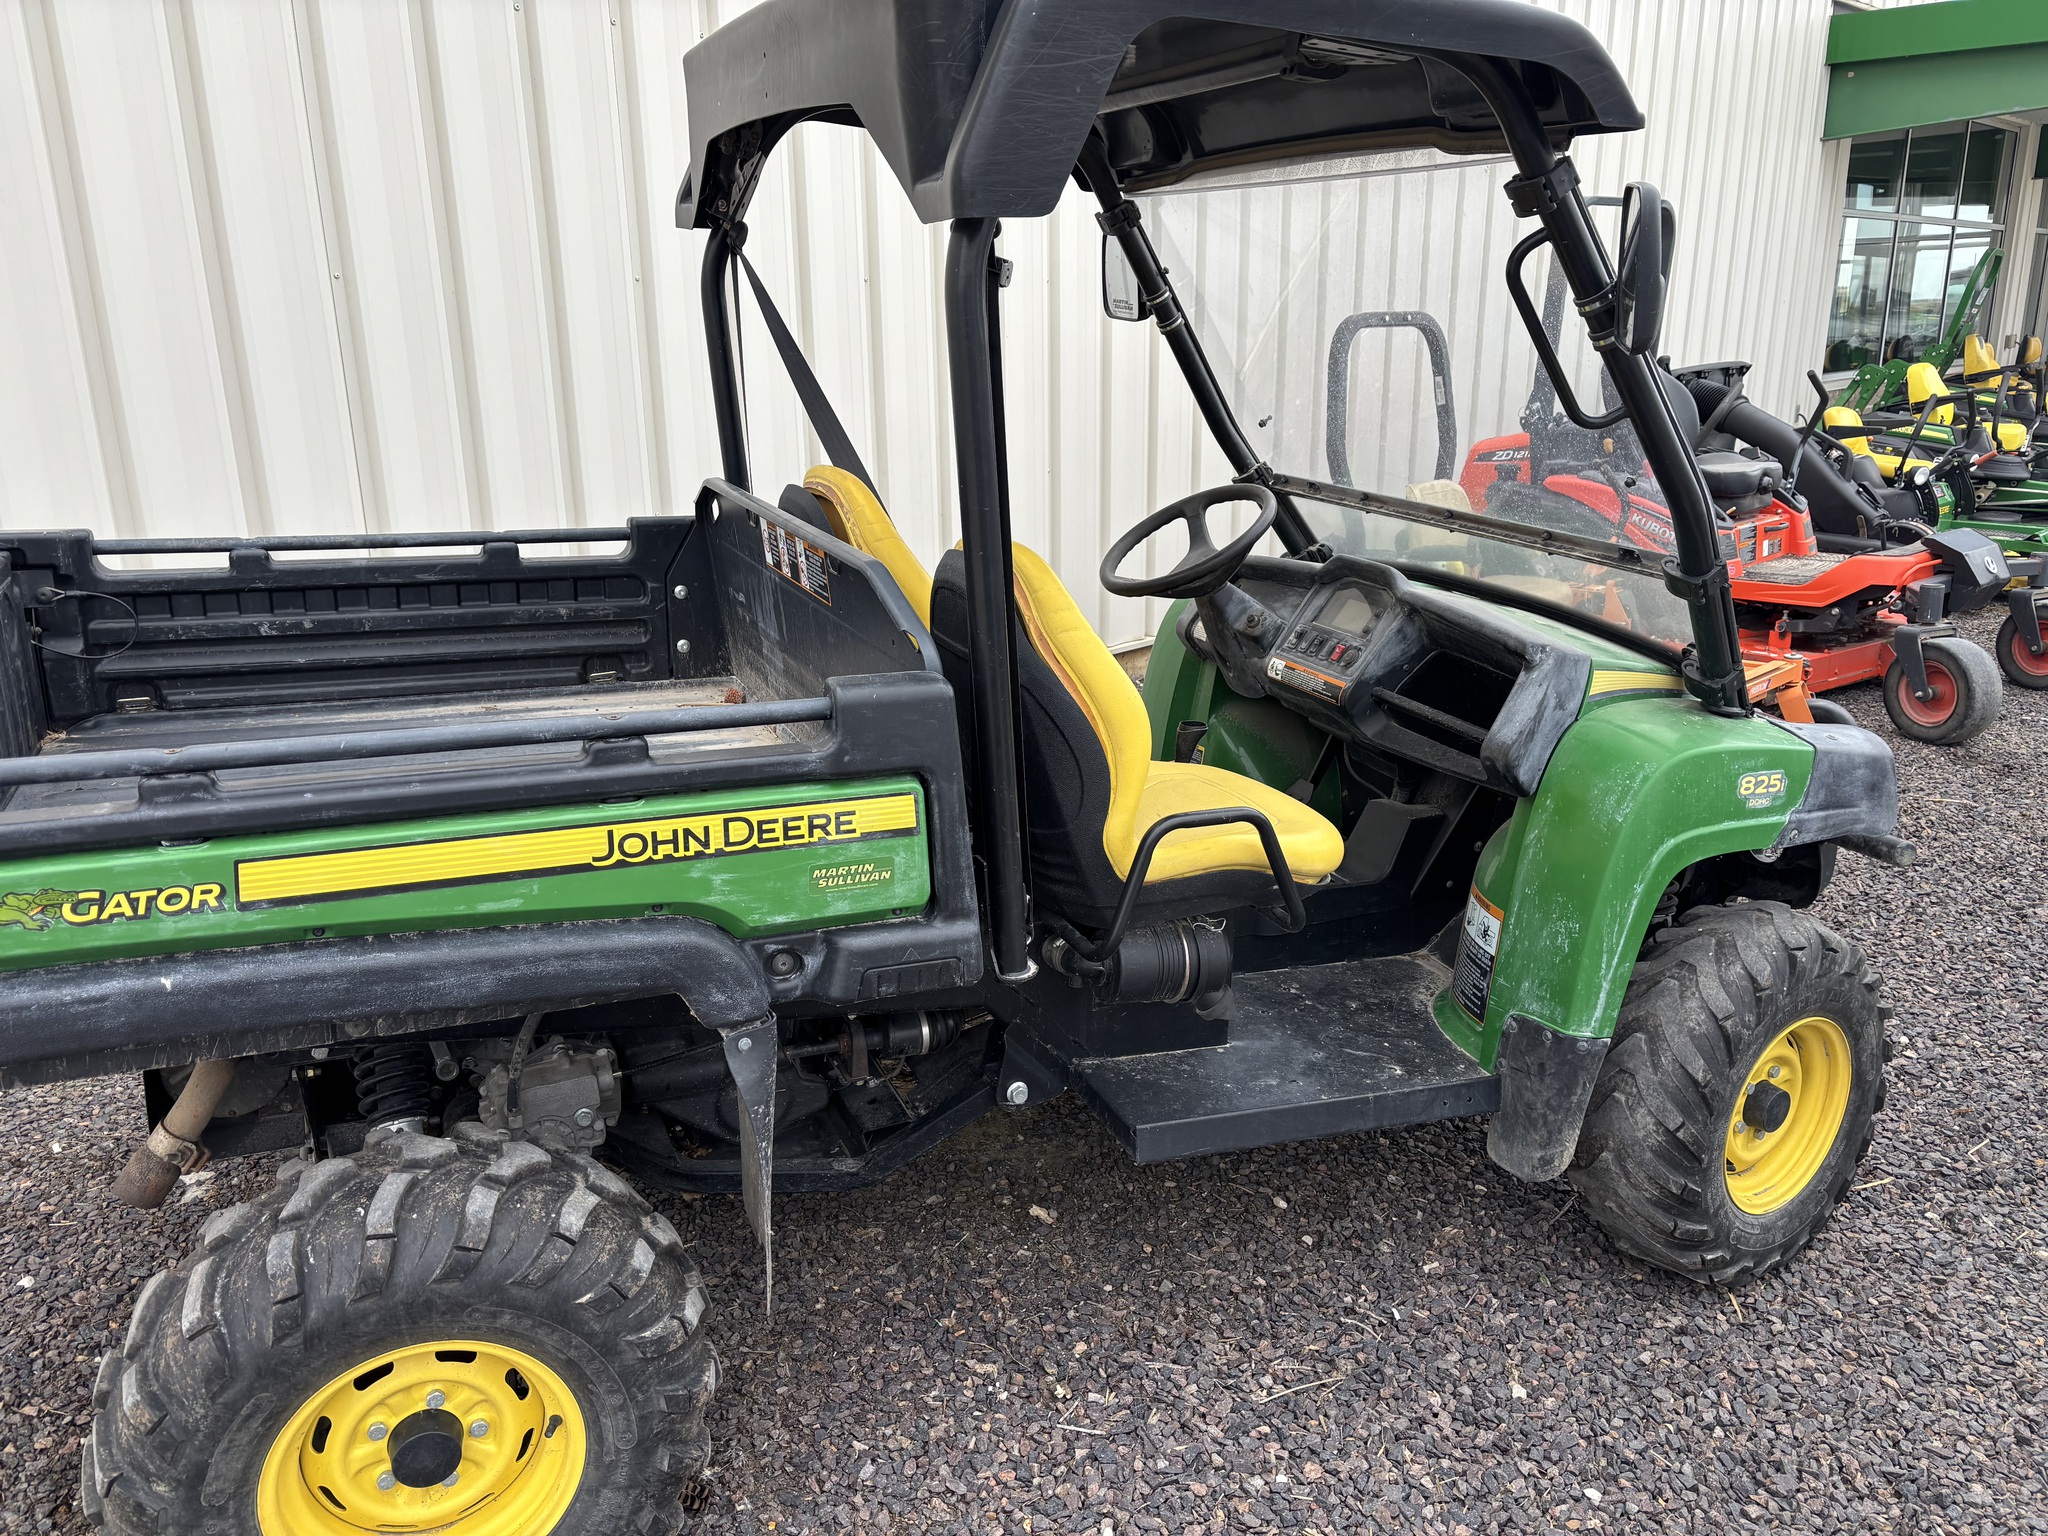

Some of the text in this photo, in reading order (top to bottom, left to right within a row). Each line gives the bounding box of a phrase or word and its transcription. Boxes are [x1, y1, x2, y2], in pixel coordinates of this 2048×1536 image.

[1492, 450, 1530, 461] ZD121
[1630, 512, 1676, 541] KUBOT
[1739, 774, 1785, 795] 825i
[592, 809, 858, 863] JOHN DEERE
[812, 863, 875, 879] MARTIN
[817, 870, 892, 888] SULLIVAN
[61, 883, 225, 925] GATOR
